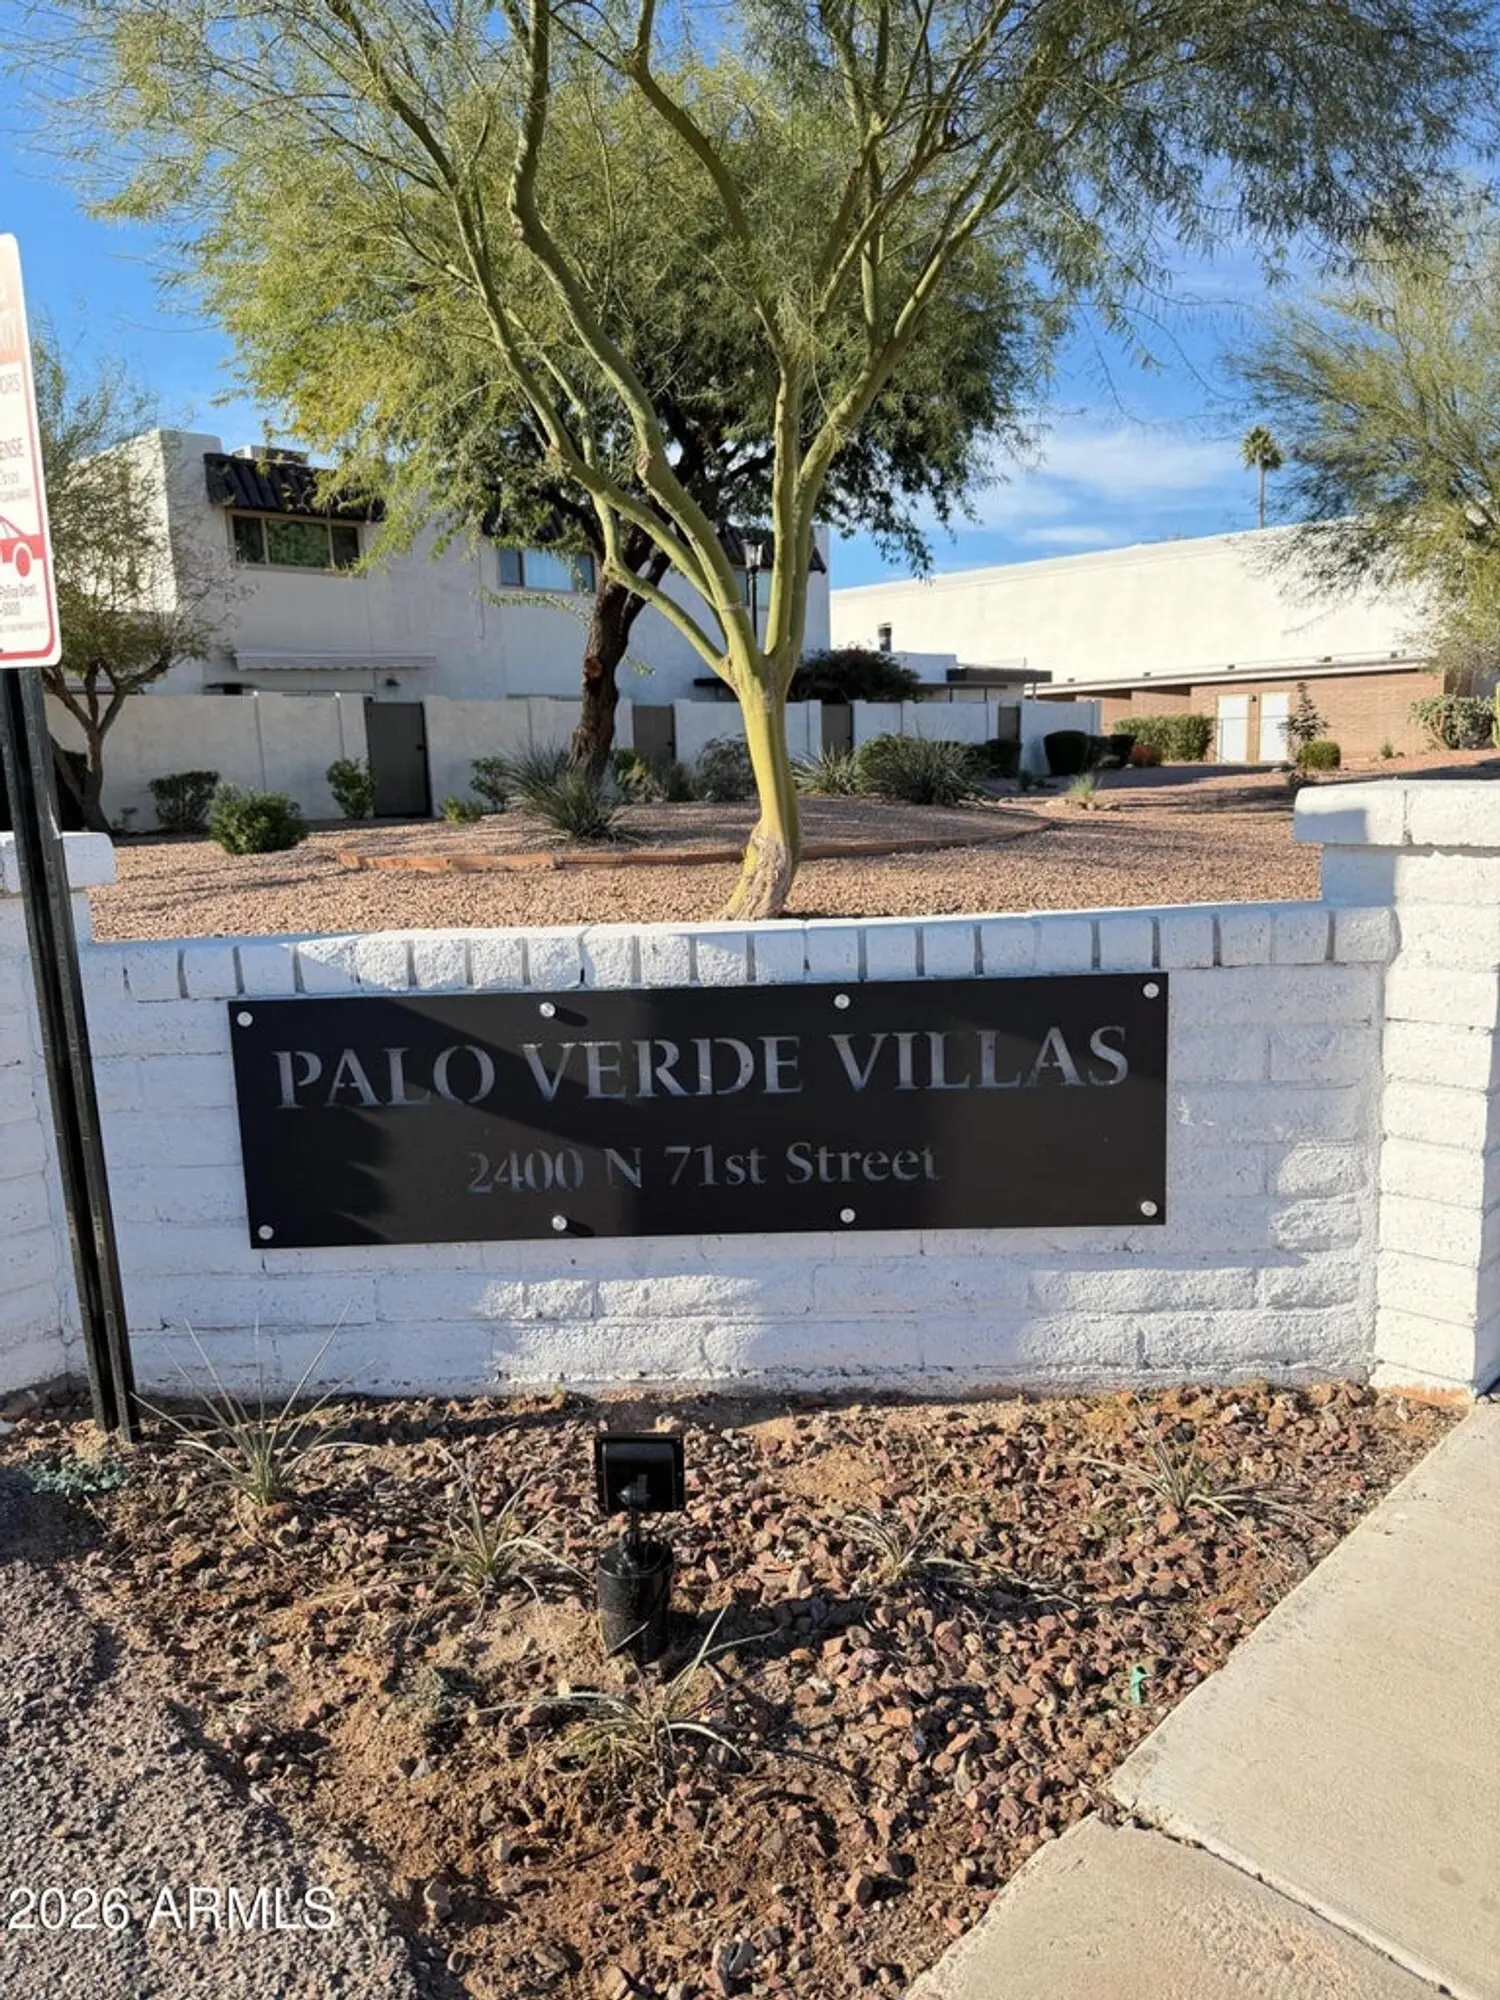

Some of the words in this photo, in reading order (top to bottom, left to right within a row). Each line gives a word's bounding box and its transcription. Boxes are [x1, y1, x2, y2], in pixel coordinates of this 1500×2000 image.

[273, 1045, 496, 1110] PALO
[522, 1036, 804, 1101] VERDE
[828, 1026, 1130, 1092] VILLAS
[468, 1147, 585, 1195] 2400
[604, 1146, 643, 1189] N
[665, 1144, 767, 1187] 71st
[785, 1140, 941, 1185] Street
